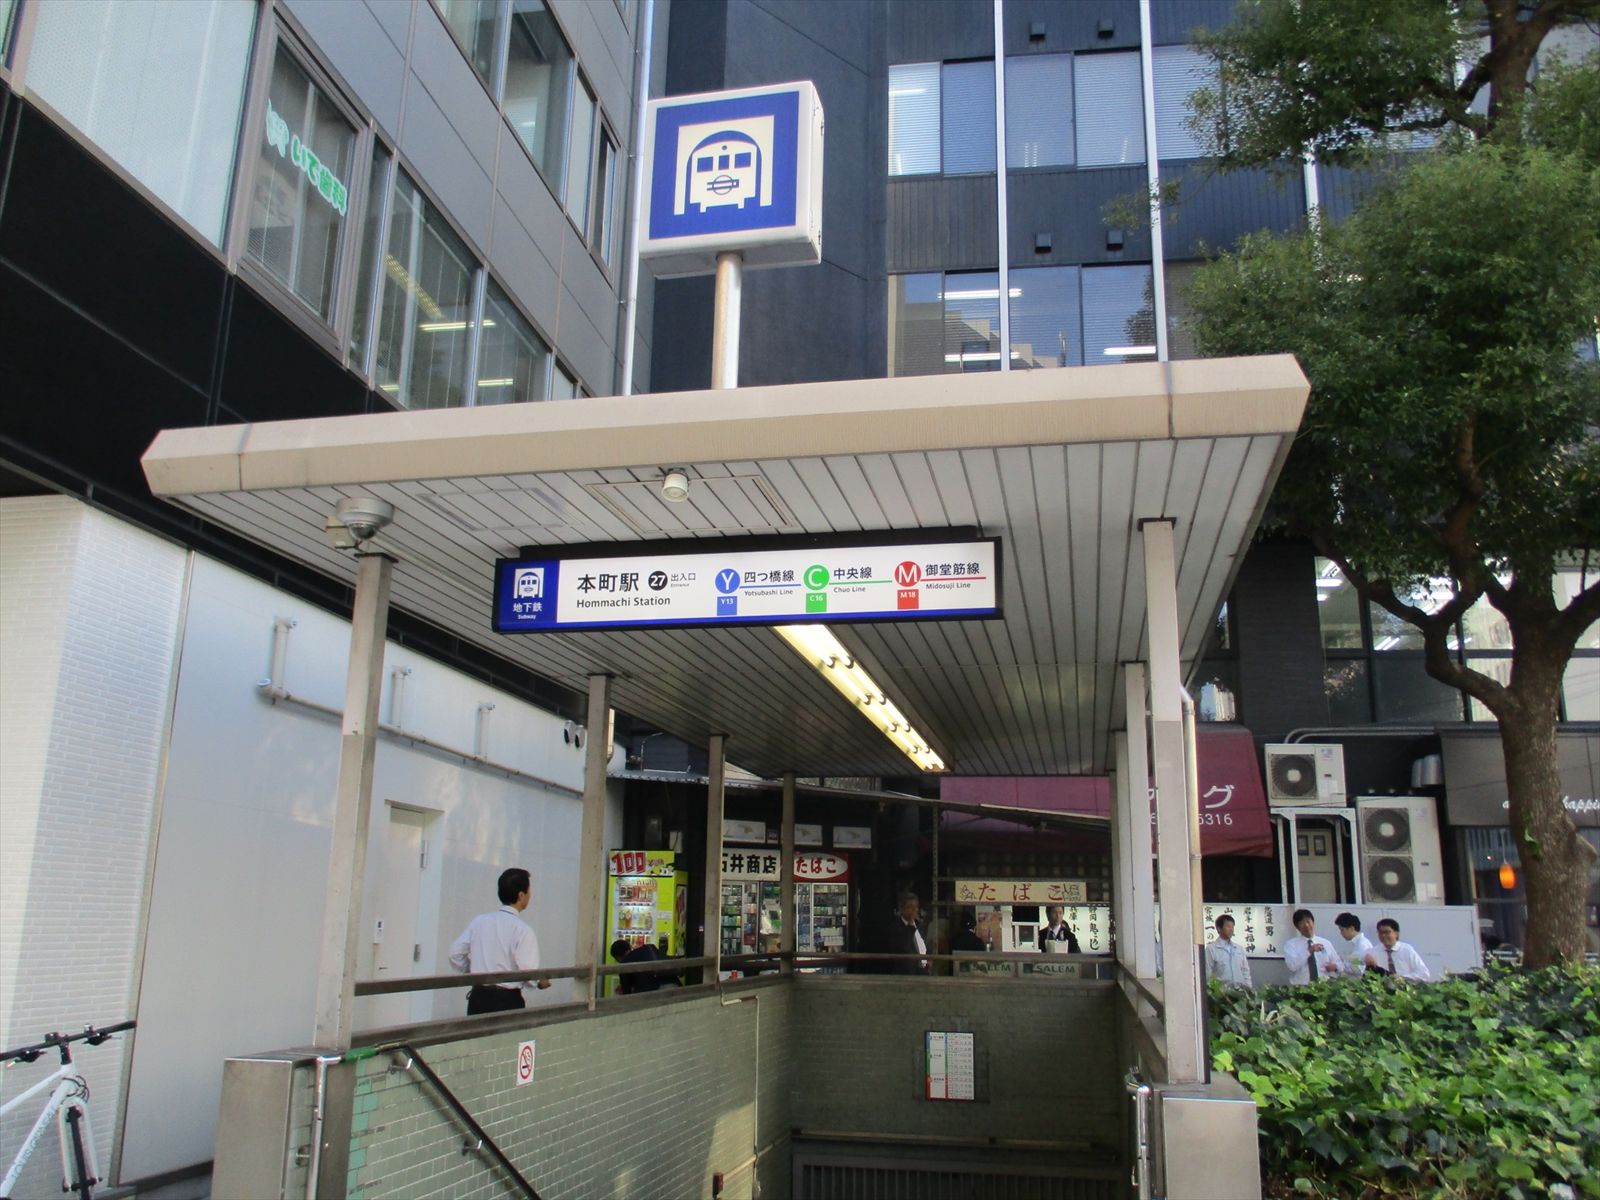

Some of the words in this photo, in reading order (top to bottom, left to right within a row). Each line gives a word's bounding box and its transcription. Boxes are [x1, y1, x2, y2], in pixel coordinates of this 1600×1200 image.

[834, 567, 873, 581] 中央線
[898, 565, 917, 584] M
[925, 562, 980, 576] 御堂筋線
[577, 572, 639, 593] 本町駅
[650, 574, 666, 587] 27
[671, 572, 697, 582] 出入口
[721, 573, 734, 591] Y
[744, 570, 795, 584] 四つ橋線
[808, 568, 823, 588] C
[744, 589, 778, 597] Yotsubashi
[852, 585, 866, 593] Line
[926, 582, 955, 591] Midosuji
[957, 581, 971, 589] Line
[512, 602, 543, 613] 地下鉄
[577, 597, 631, 609] Hommachi
[633, 596, 671, 607] Station
[611, 852, 647, 874] 100
[796, 855, 837, 874] たばこ
[978, 882, 1064, 901] たばこ
[1032, 963, 1075, 976] SALEM
